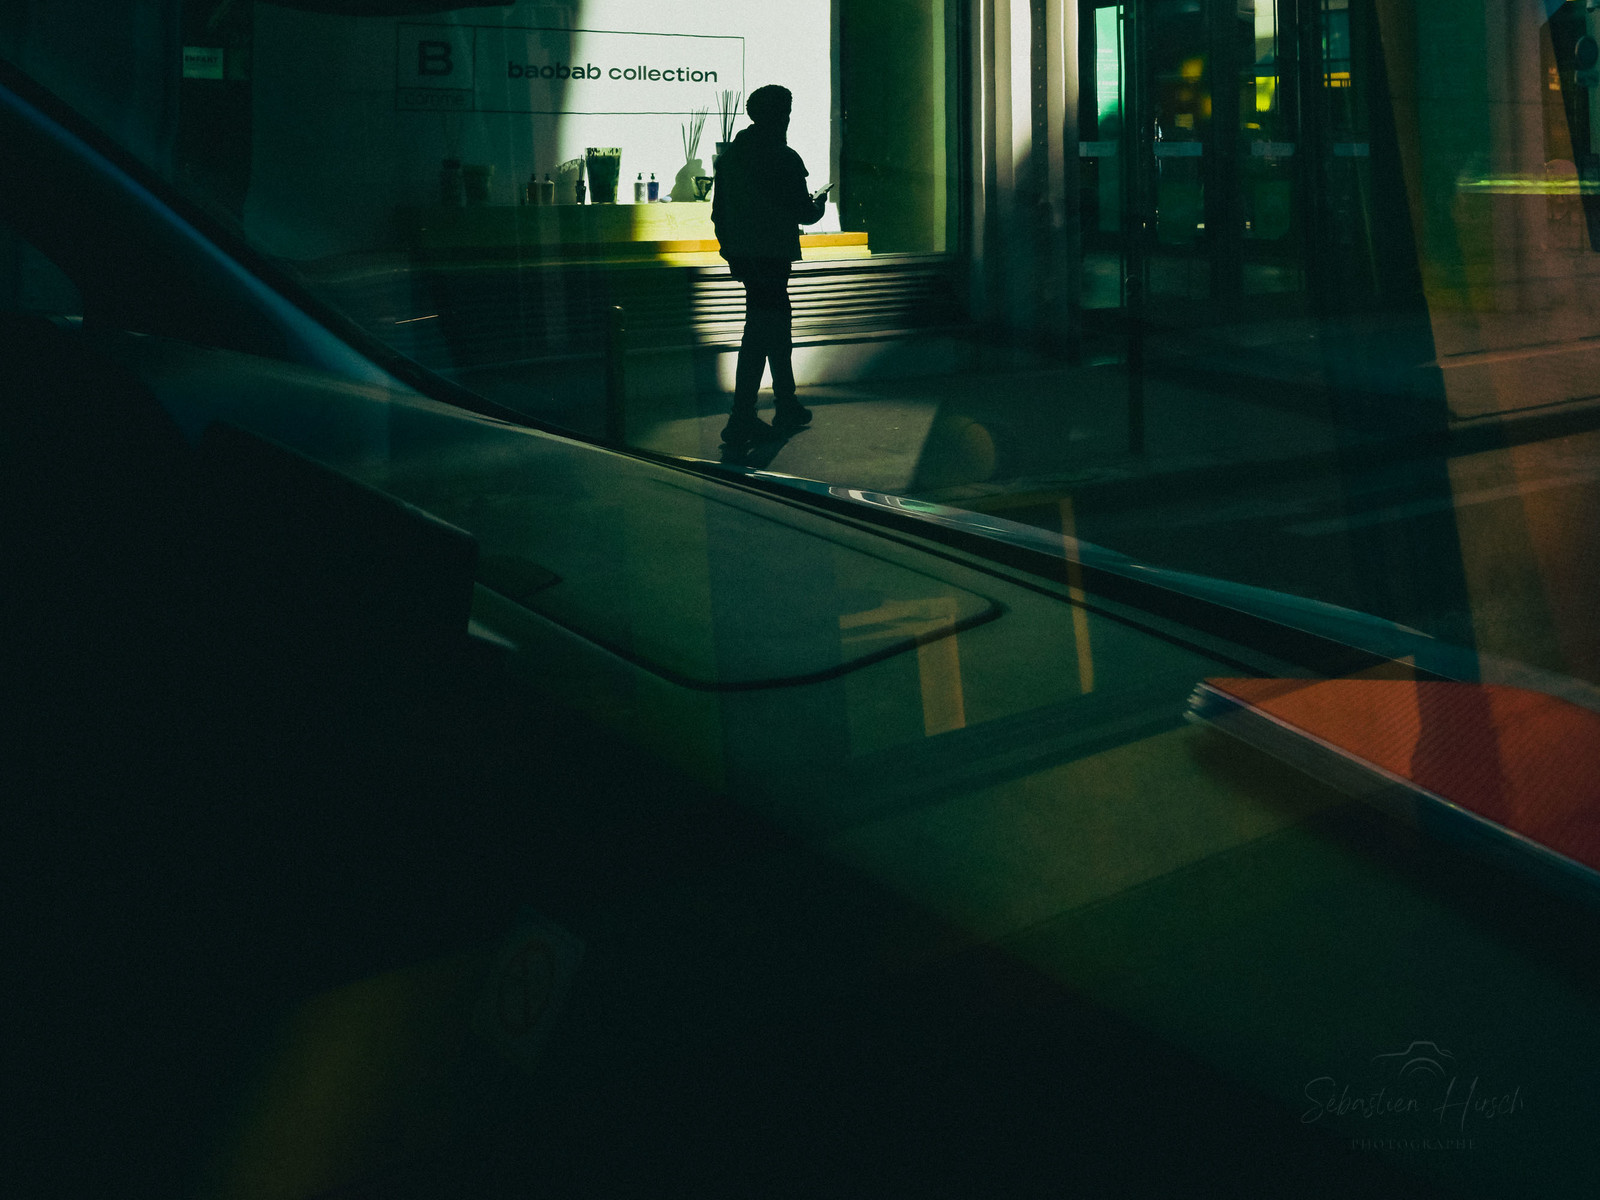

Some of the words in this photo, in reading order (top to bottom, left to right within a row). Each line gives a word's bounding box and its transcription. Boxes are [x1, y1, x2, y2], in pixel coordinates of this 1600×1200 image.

[419, 41, 452, 75] B
[508, 61, 600, 80] baobab
[608, 65, 718, 83] collection
